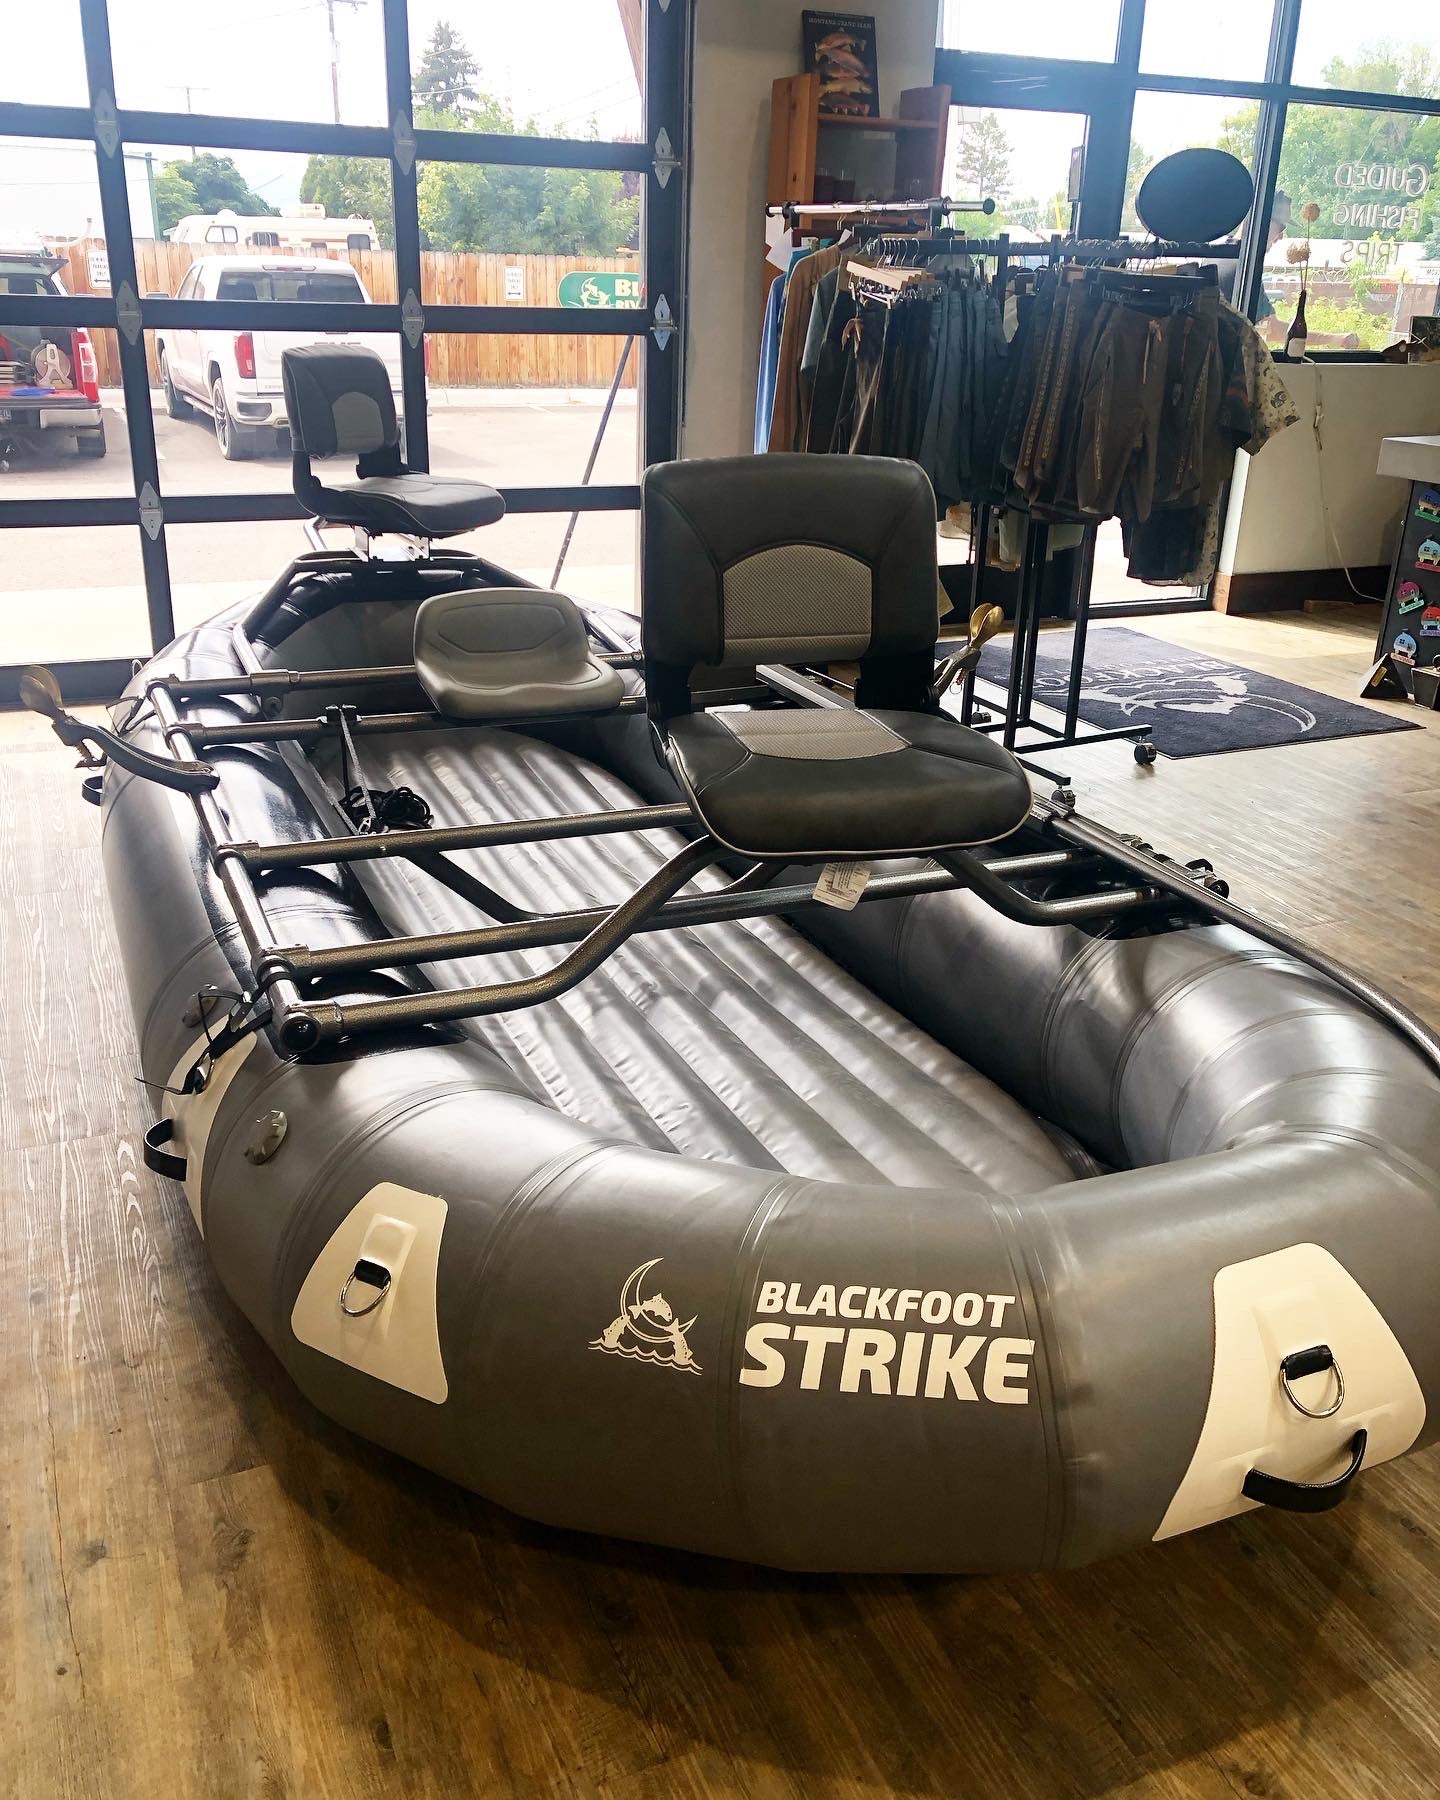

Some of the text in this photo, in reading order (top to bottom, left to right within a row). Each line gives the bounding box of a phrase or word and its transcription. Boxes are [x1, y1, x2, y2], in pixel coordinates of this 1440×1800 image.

[1033, 660, 1233, 689] BLACKFOO
[756, 1281, 1016, 1328] BLACKFOOT
[739, 1322, 1036, 1405] STRIKE
